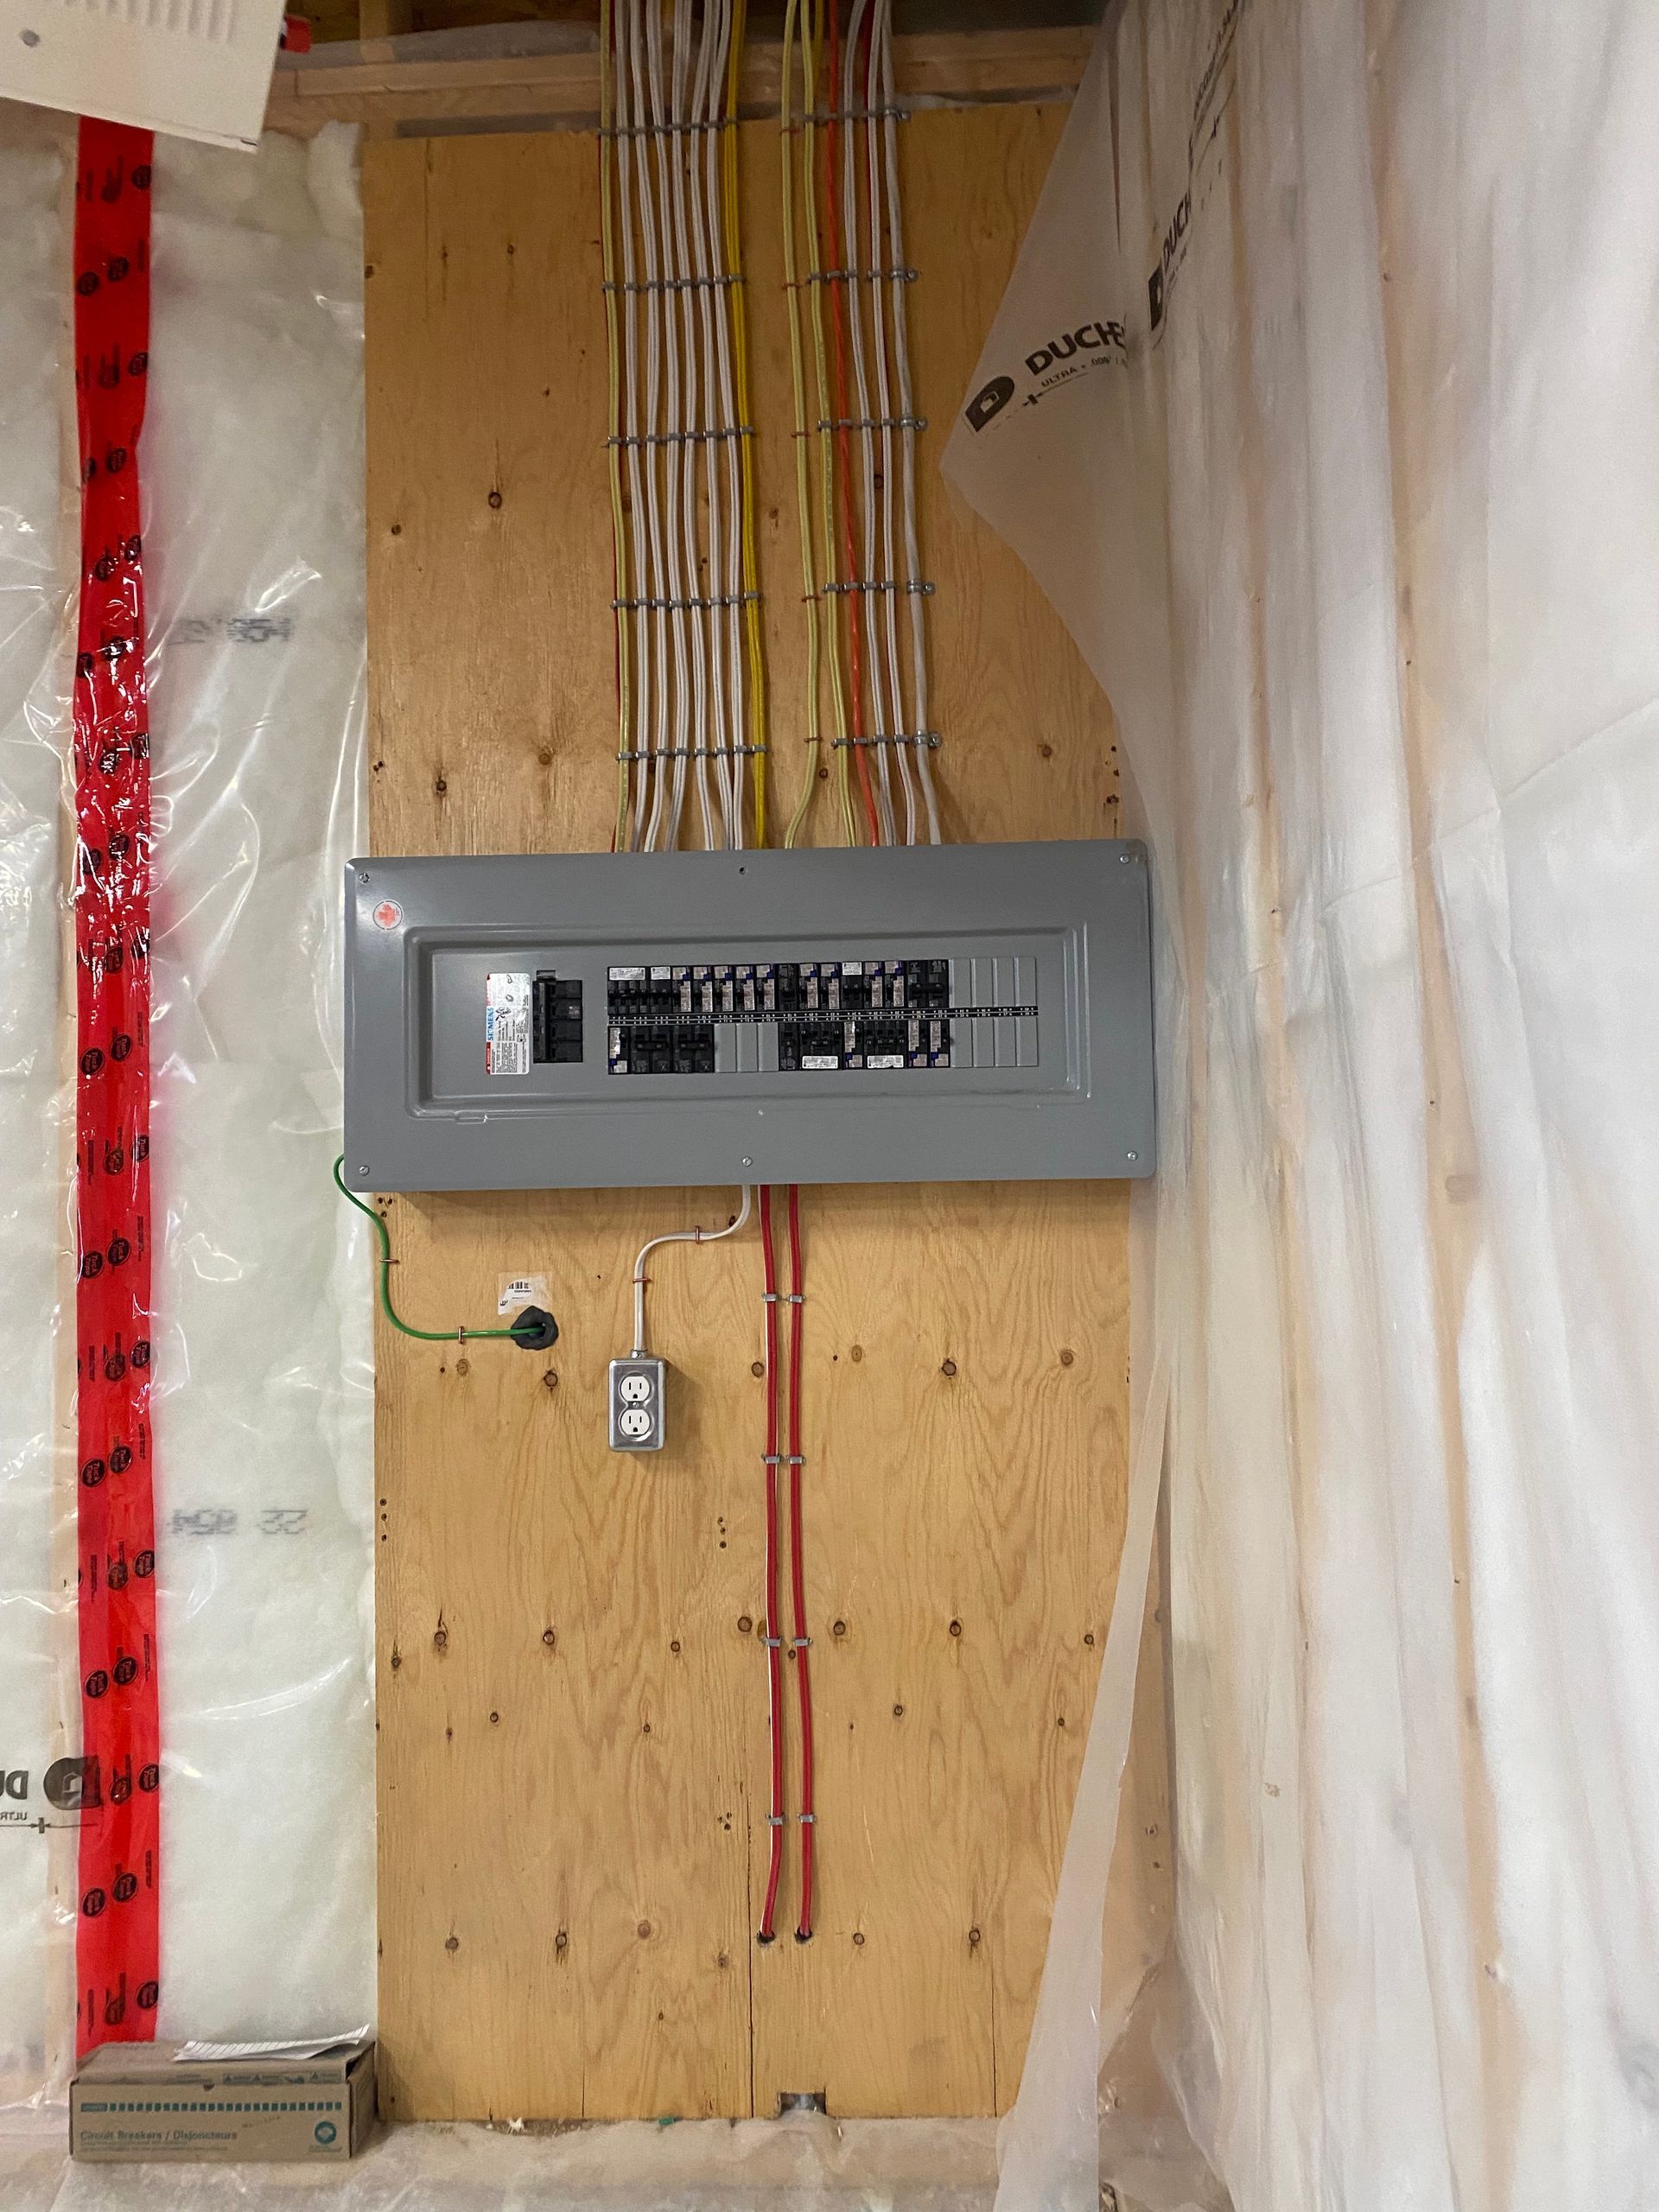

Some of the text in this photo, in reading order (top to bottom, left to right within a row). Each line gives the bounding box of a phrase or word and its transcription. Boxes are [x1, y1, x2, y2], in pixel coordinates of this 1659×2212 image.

[1025, 321, 1124, 376] DUCH
[80, 2130, 114, 2141] Circuit
[118, 2130, 162, 2140] Breakers
[173, 2130, 238, 2142] Disjoncteurs
